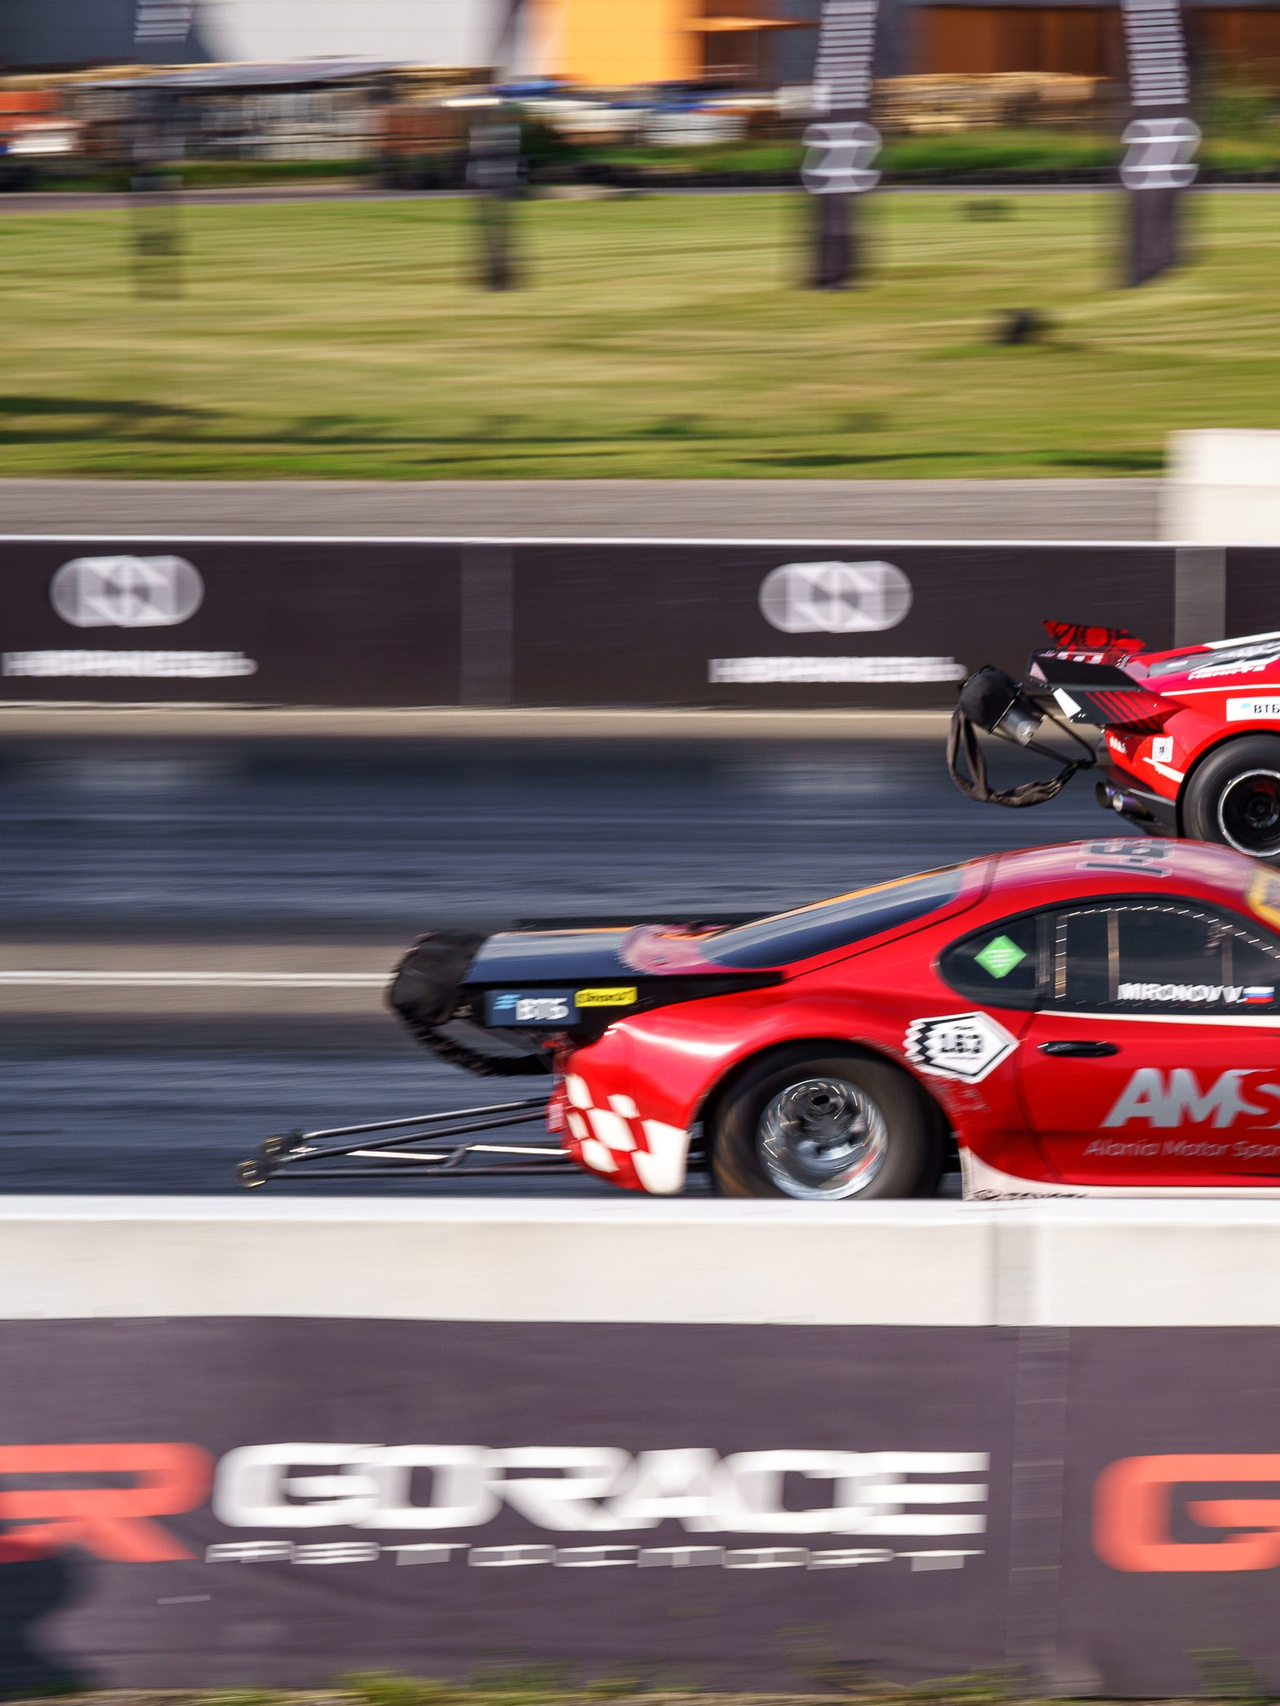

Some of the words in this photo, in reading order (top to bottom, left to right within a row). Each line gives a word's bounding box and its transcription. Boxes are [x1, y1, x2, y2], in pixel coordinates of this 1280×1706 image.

[1253, 703, 1280, 714] ВТБ
[1083, 1138, 1160, 1157] Alania
[1162, 1139, 1234, 1157] Motor
[213, 1442, 989, 1534] GORACE
